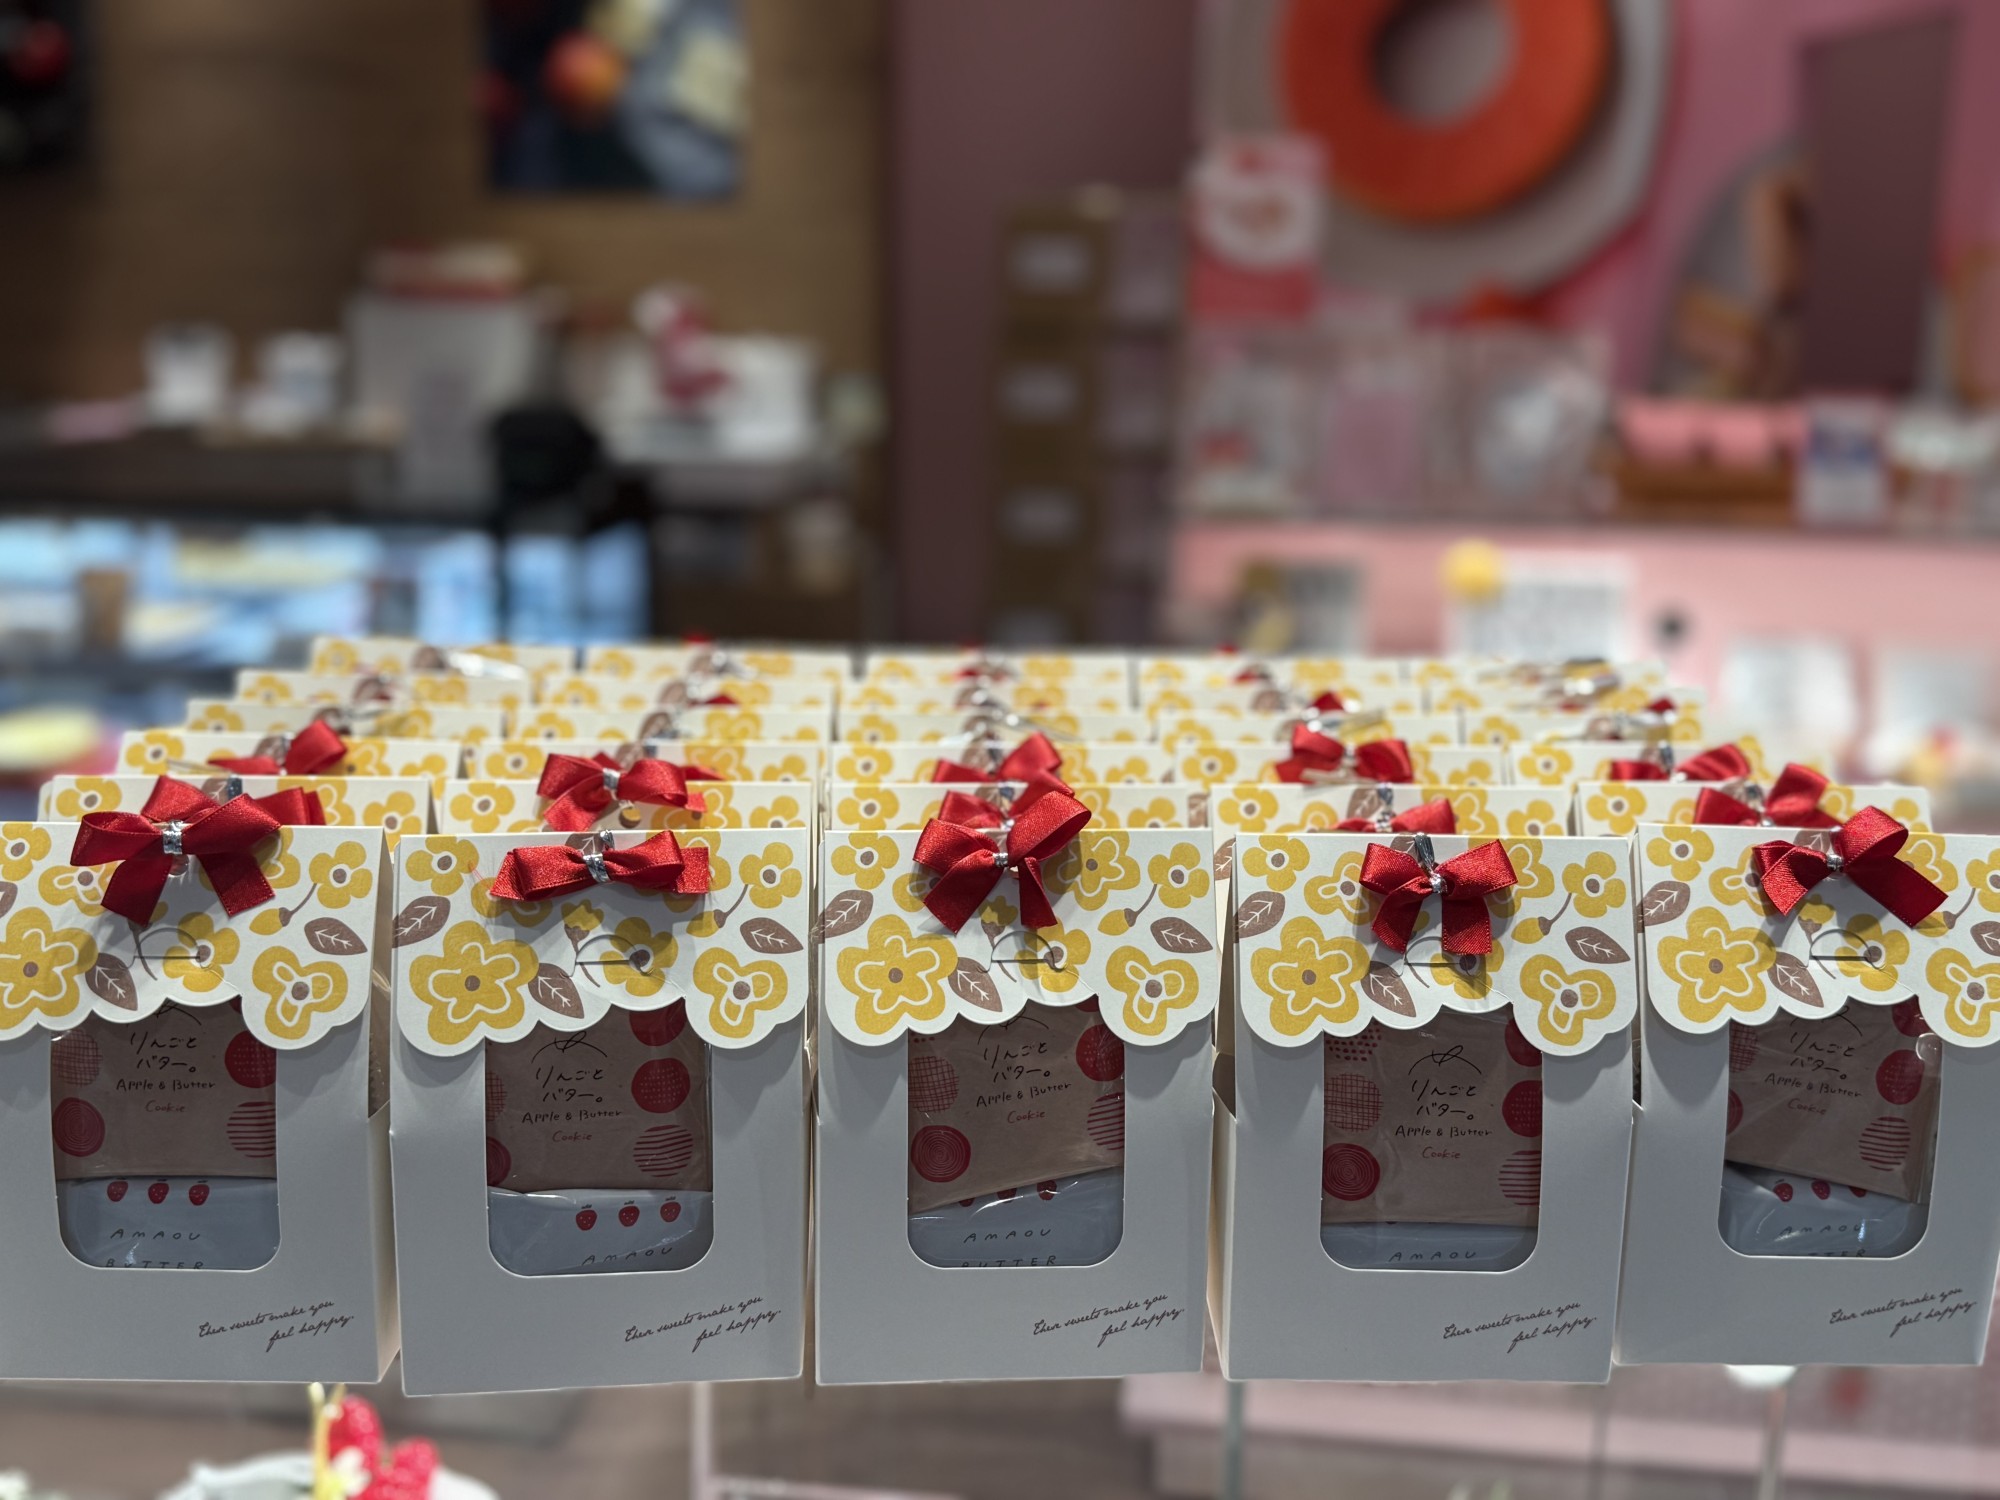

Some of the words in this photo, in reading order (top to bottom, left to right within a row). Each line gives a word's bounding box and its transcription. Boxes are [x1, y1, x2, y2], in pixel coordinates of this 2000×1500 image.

[130, 1031, 197, 1055] りんごと
[1790, 1031, 1855, 1057] りんごと
[136, 1055, 197, 1073] バター。
[983, 1042, 1048, 1069] りんごと
[116, 1078, 154, 1092] Apple
[158, 1082, 166, 1090] &
[172, 1079, 216, 1092] Butter
[535, 1065, 604, 1089] りんごと
[993, 1065, 1051, 1083] バター。
[1764, 1072, 1802, 1087] Apple
[1819, 1082, 1862, 1097] Butter
[542, 1088, 603, 1103] バター。
[976, 1091, 1012, 1108] Apple
[1017, 1090, 1024, 1100] &
[1029, 1083, 1072, 1099] Butter
[1411, 1079, 1477, 1101] りんごと
[144, 1100, 186, 1113] Cookie
[521, 1111, 560, 1125] Apple
[565, 1112, 573, 1121] &
[579, 1109, 622, 1121] Butter
[1007, 1110, 1046, 1124] Cookie
[1416, 1102, 1474, 1120] バター。
[552, 1130, 593, 1142] Cookie
[1395, 1125, 1432, 1138] Apple
[1436, 1127, 1443, 1137] &
[1449, 1126, 1493, 1139] Butter
[1422, 1146, 1461, 1159] Cookie
[110, 1228, 201, 1241] AMAOU
[963, 1229, 1052, 1243] AMAOU
[1388, 1251, 1476, 1263] AMAOU
[1064, 1307, 1109, 1326] sweets
[1103, 1300, 1140, 1316] make
[1142, 1294, 1168, 1311] you
[1860, 1299, 1904, 1316] sweets
[1899, 1292, 1936, 1307] make
[1938, 1287, 1963, 1303] you
[229, 1312, 273, 1330] sweets
[269, 1306, 306, 1321] make
[308, 1301, 335, 1316] you
[656, 1312, 701, 1332] sweets
[697, 1303, 735, 1320] make
[737, 1296, 763, 1313] you
[1474, 1313, 1520, 1332] sweets
[1515, 1307, 1553, 1322] make
[1555, 1302, 1581, 1317] you
[1889, 1312, 1922, 1338] feel
[265, 1326, 295, 1353] feel
[691, 1324, 722, 1353] feel
[1096, 1320, 1127, 1348] feel
[1507, 1327, 1539, 1354] feel
